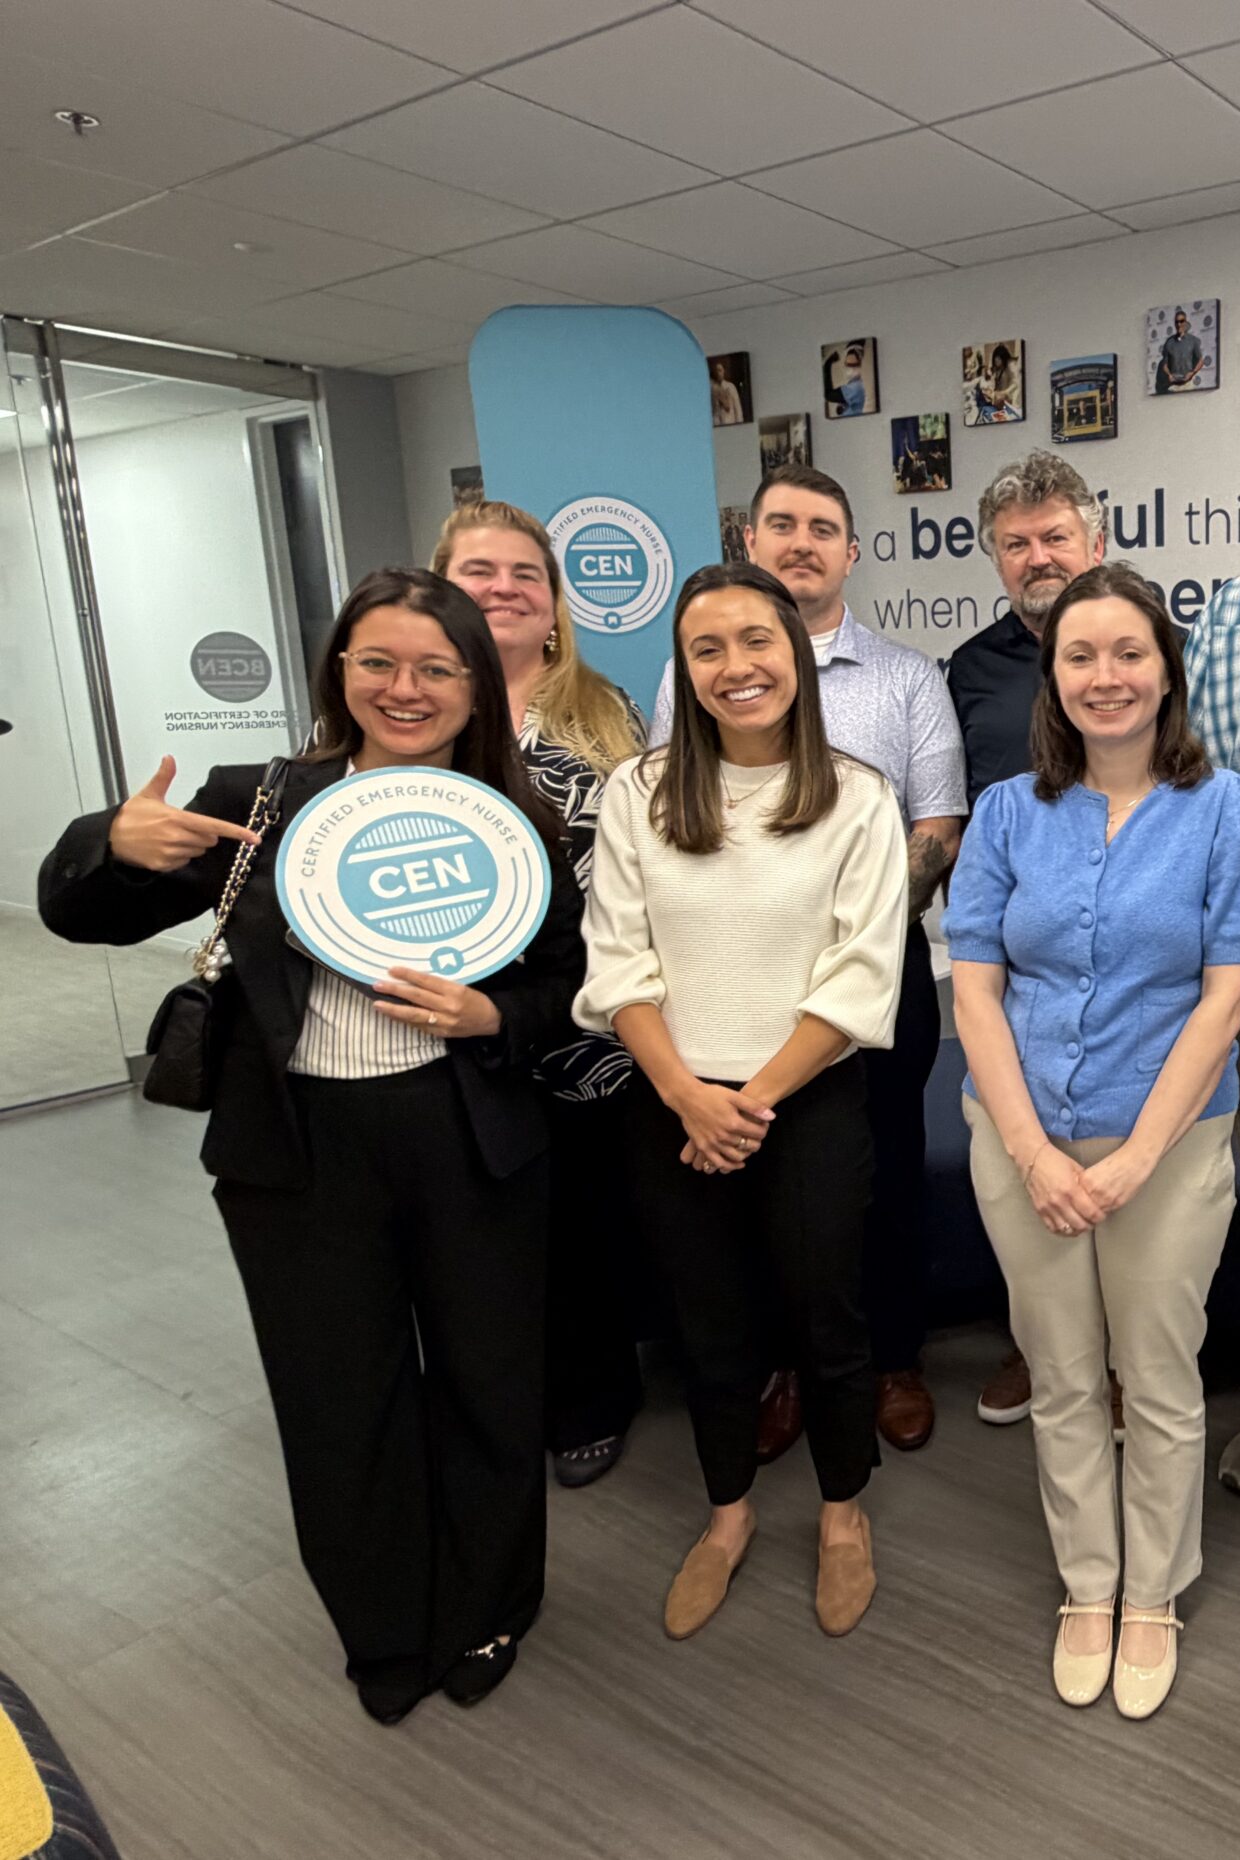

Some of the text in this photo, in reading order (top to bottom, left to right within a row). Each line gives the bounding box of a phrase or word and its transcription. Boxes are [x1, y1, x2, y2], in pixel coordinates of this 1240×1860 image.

[580, 505, 639, 525] EMERGENCY
[640, 524, 663, 555] NURSE
[874, 530, 896, 561] a
[579, 555, 633, 576] CEN
[874, 589, 978, 629] when
[301, 785, 518, 878] CERTIFIED EMERGENCY NURSE
[369, 853, 471, 899] CEN
